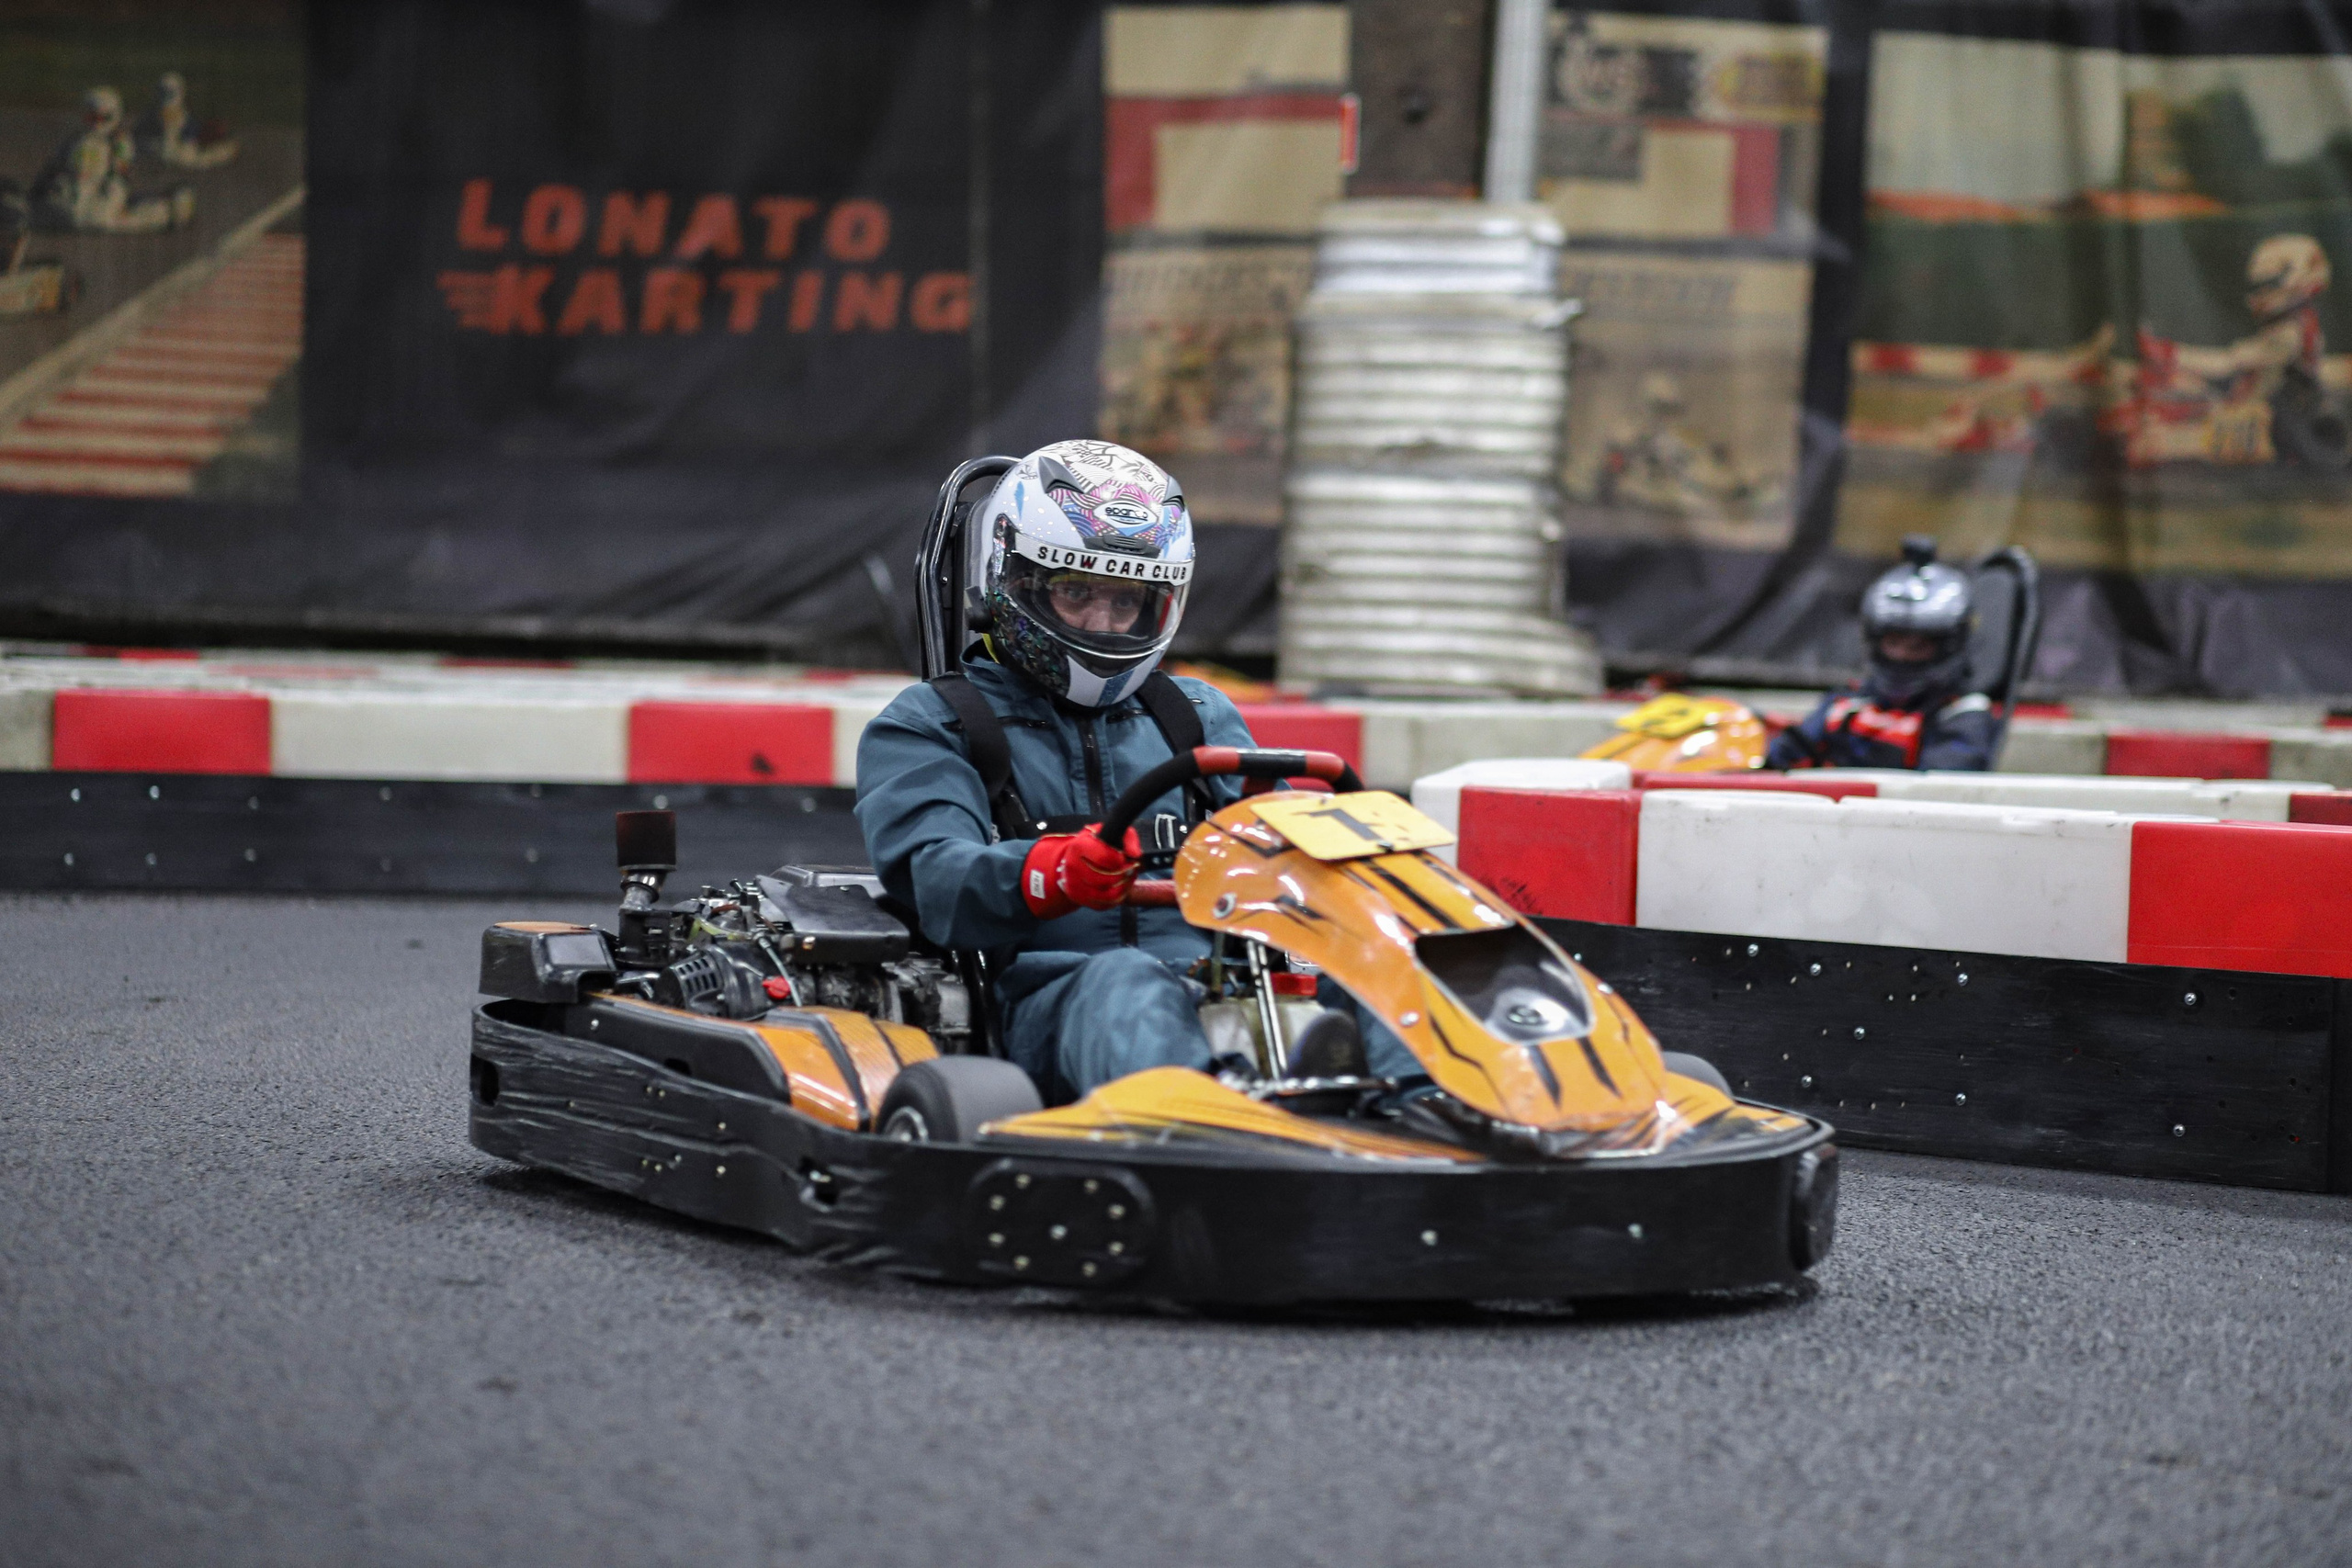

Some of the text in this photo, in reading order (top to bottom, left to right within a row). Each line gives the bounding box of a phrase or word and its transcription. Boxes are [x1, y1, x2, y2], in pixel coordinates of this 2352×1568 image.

[458, 177, 891, 261] LONATO
[437, 264, 973, 334] KARTING
[1037, 547, 1187, 580] SLOW CAR CLUB
